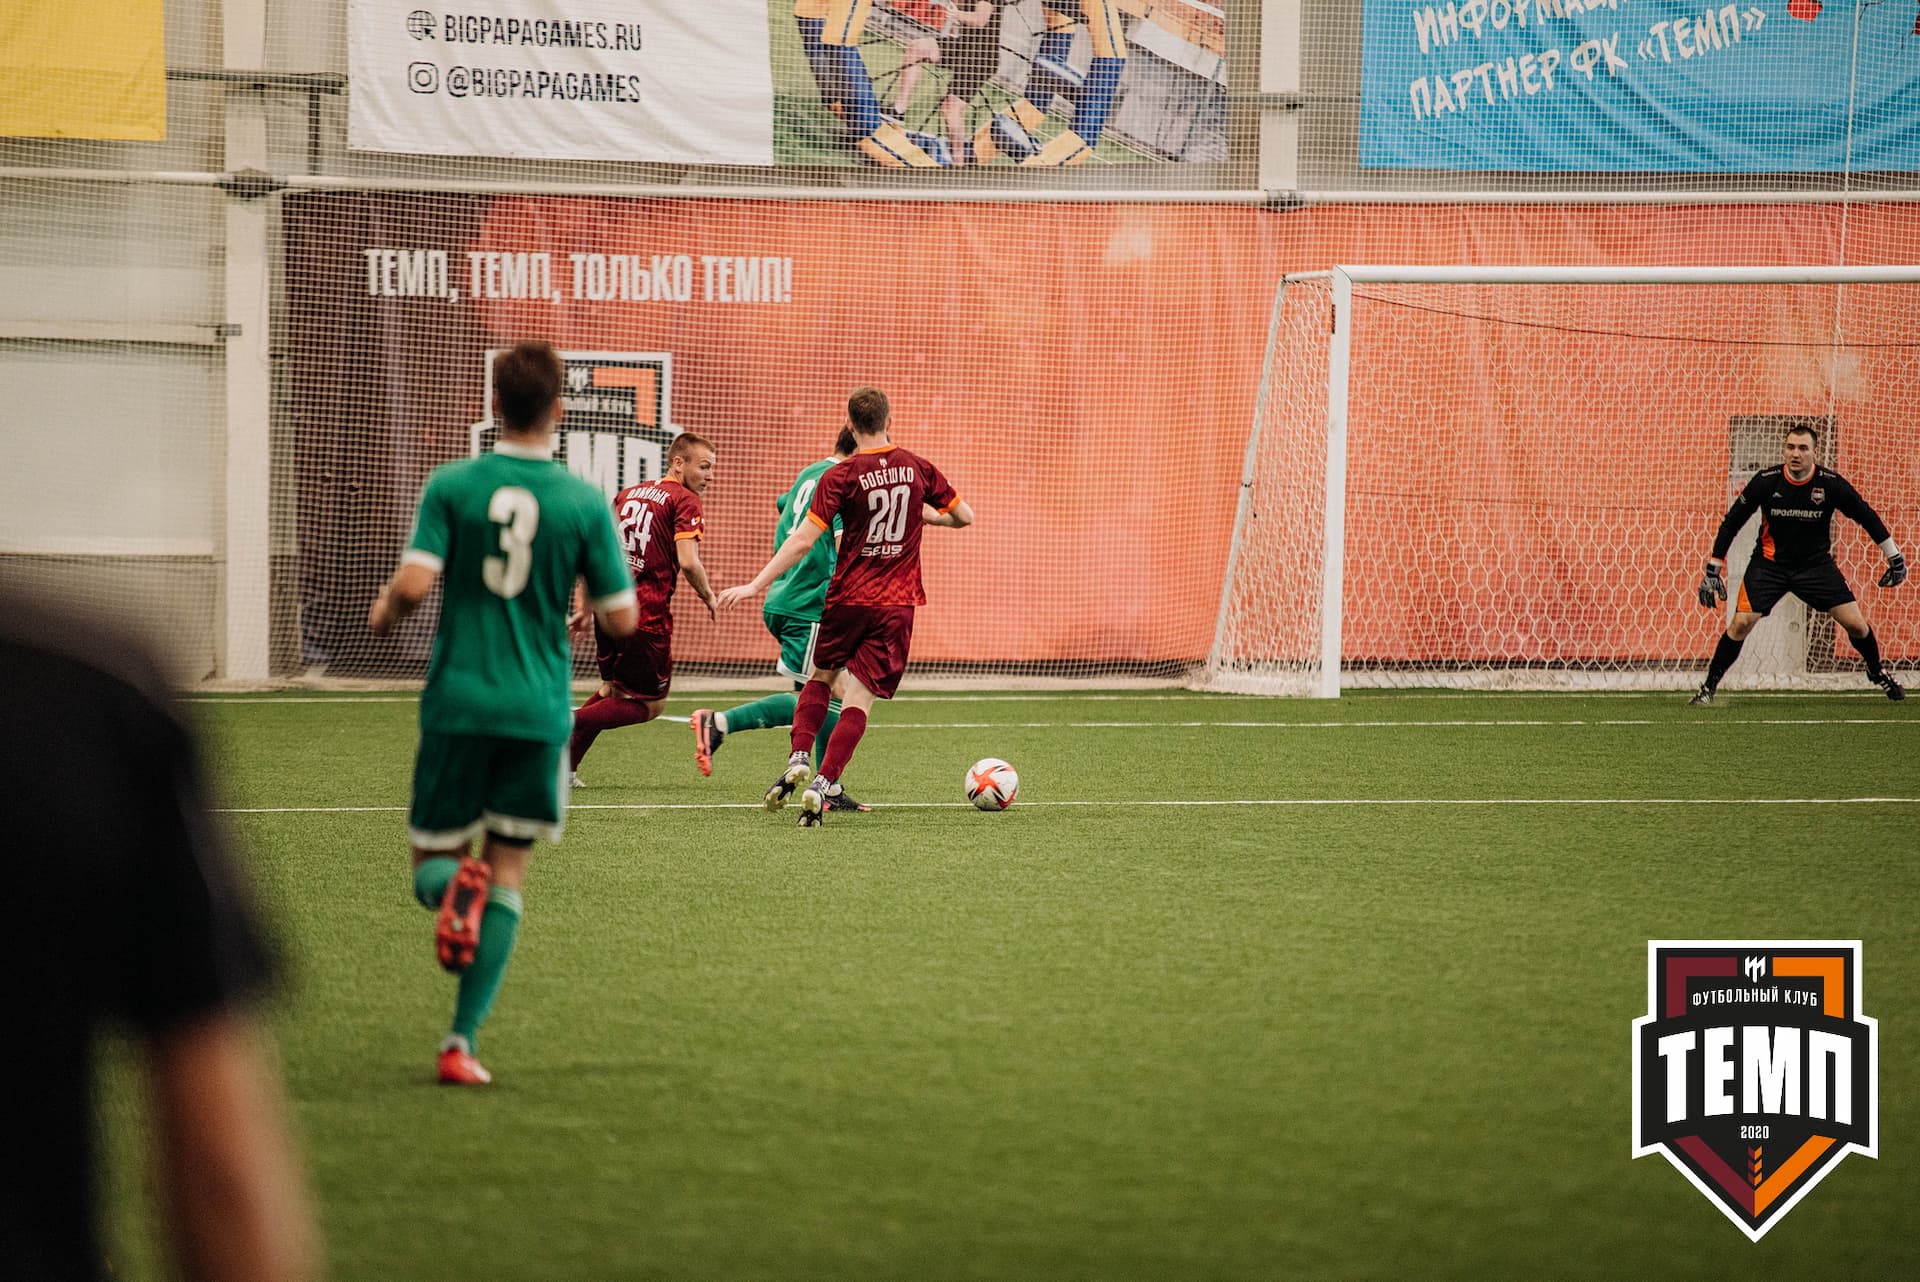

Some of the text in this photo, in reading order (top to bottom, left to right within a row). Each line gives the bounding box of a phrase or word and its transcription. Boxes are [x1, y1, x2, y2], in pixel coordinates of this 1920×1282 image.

[444, 14, 642, 51] BIGPAPAGAMES.RU
[446, 65, 642, 103] @BIGPAPAGAMES
[1409, 4, 1767, 120] ПАРТНЕР ФК «ТЕМП»
[365, 248, 793, 305] ТЕМП, ТЕМП, ТОЛЬКО ТЕМП!
[618, 500, 653, 556] 24
[786, 479, 816, 535] 9
[865, 485, 910, 544] 20
[482, 485, 540, 599] 3
